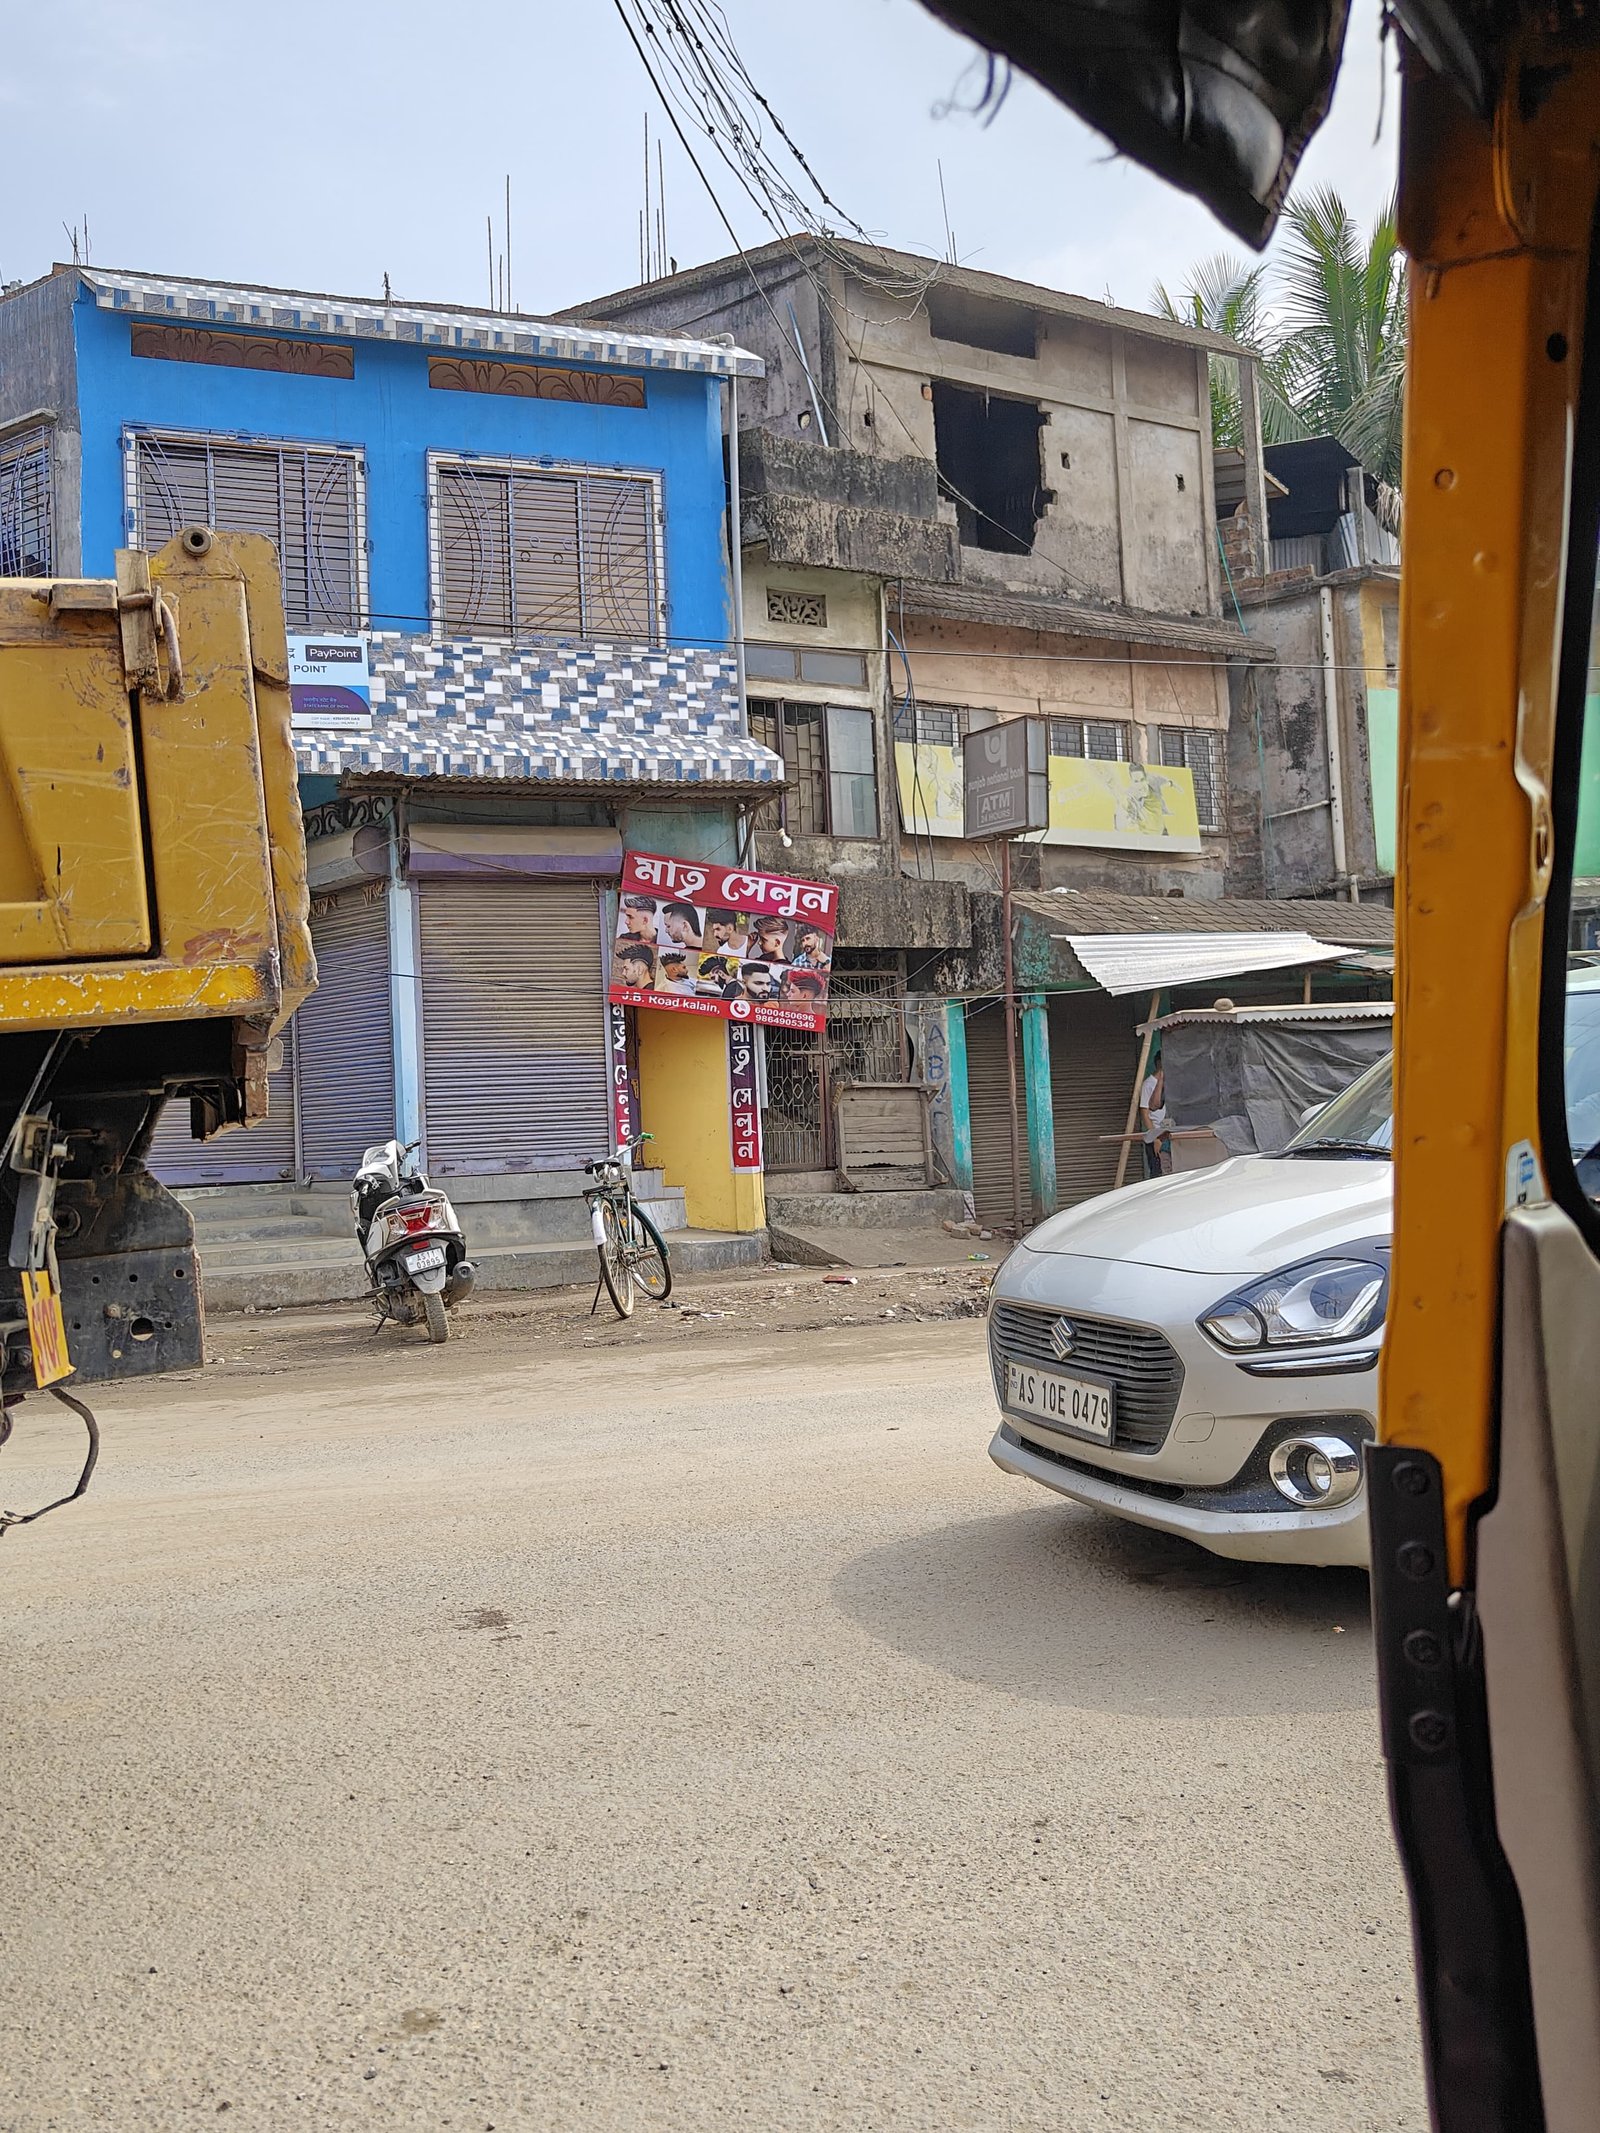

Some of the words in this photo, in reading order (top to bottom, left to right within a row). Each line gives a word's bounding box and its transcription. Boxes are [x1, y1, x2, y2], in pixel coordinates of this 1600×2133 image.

[310, 648, 358, 659] PayPoint
[294, 665, 327, 673] POINT
[981, 791, 1010, 814] ATM
[634, 857, 710, 903] মাতৃ
[722, 873, 834, 917] সেলুন
[649, 995, 680, 1007] Road
[683, 1000, 720, 1014] kalain,
[1018, 1373, 1035, 1404] AS
[1072, 1389, 1108, 1429] 0479
